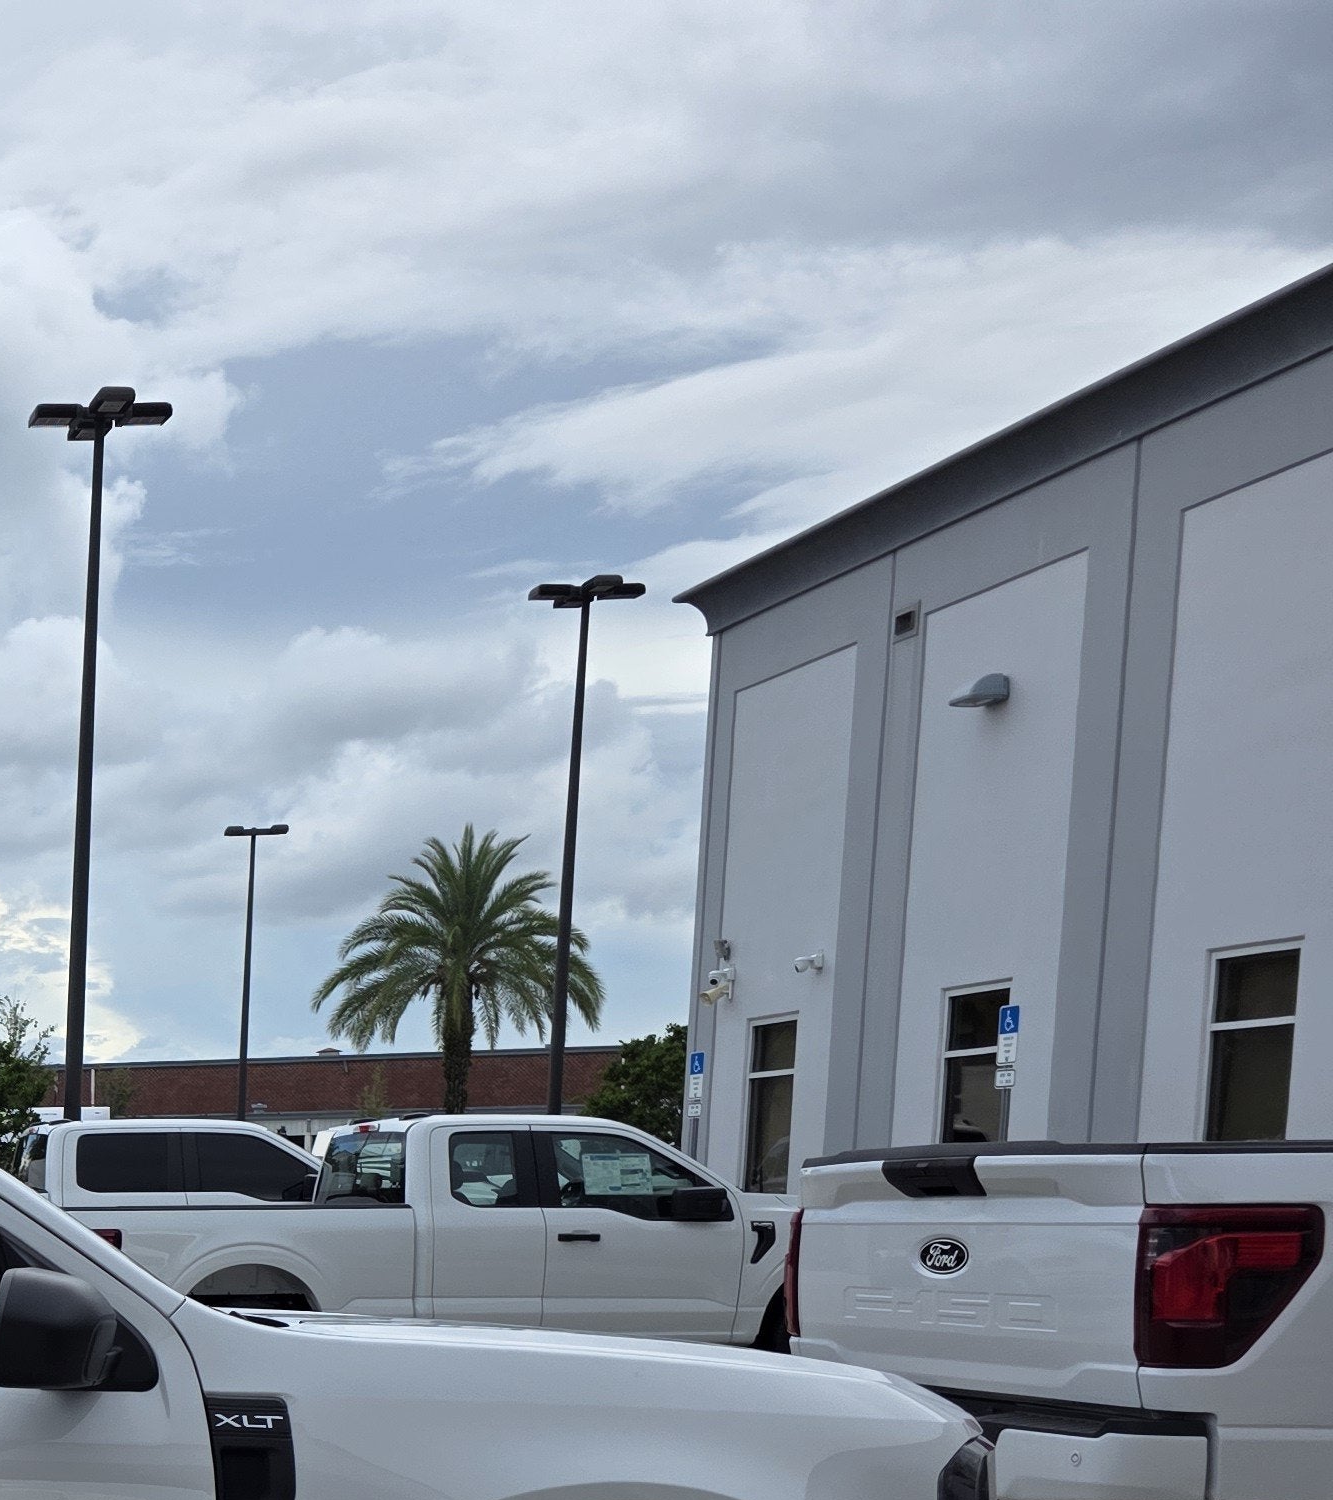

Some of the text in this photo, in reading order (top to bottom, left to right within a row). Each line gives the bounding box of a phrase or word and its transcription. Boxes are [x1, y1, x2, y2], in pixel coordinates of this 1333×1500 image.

[926, 1242, 958, 1267] Ford
[843, 1286, 1059, 1333] F-150
[214, 1413, 284, 1429] XLT
